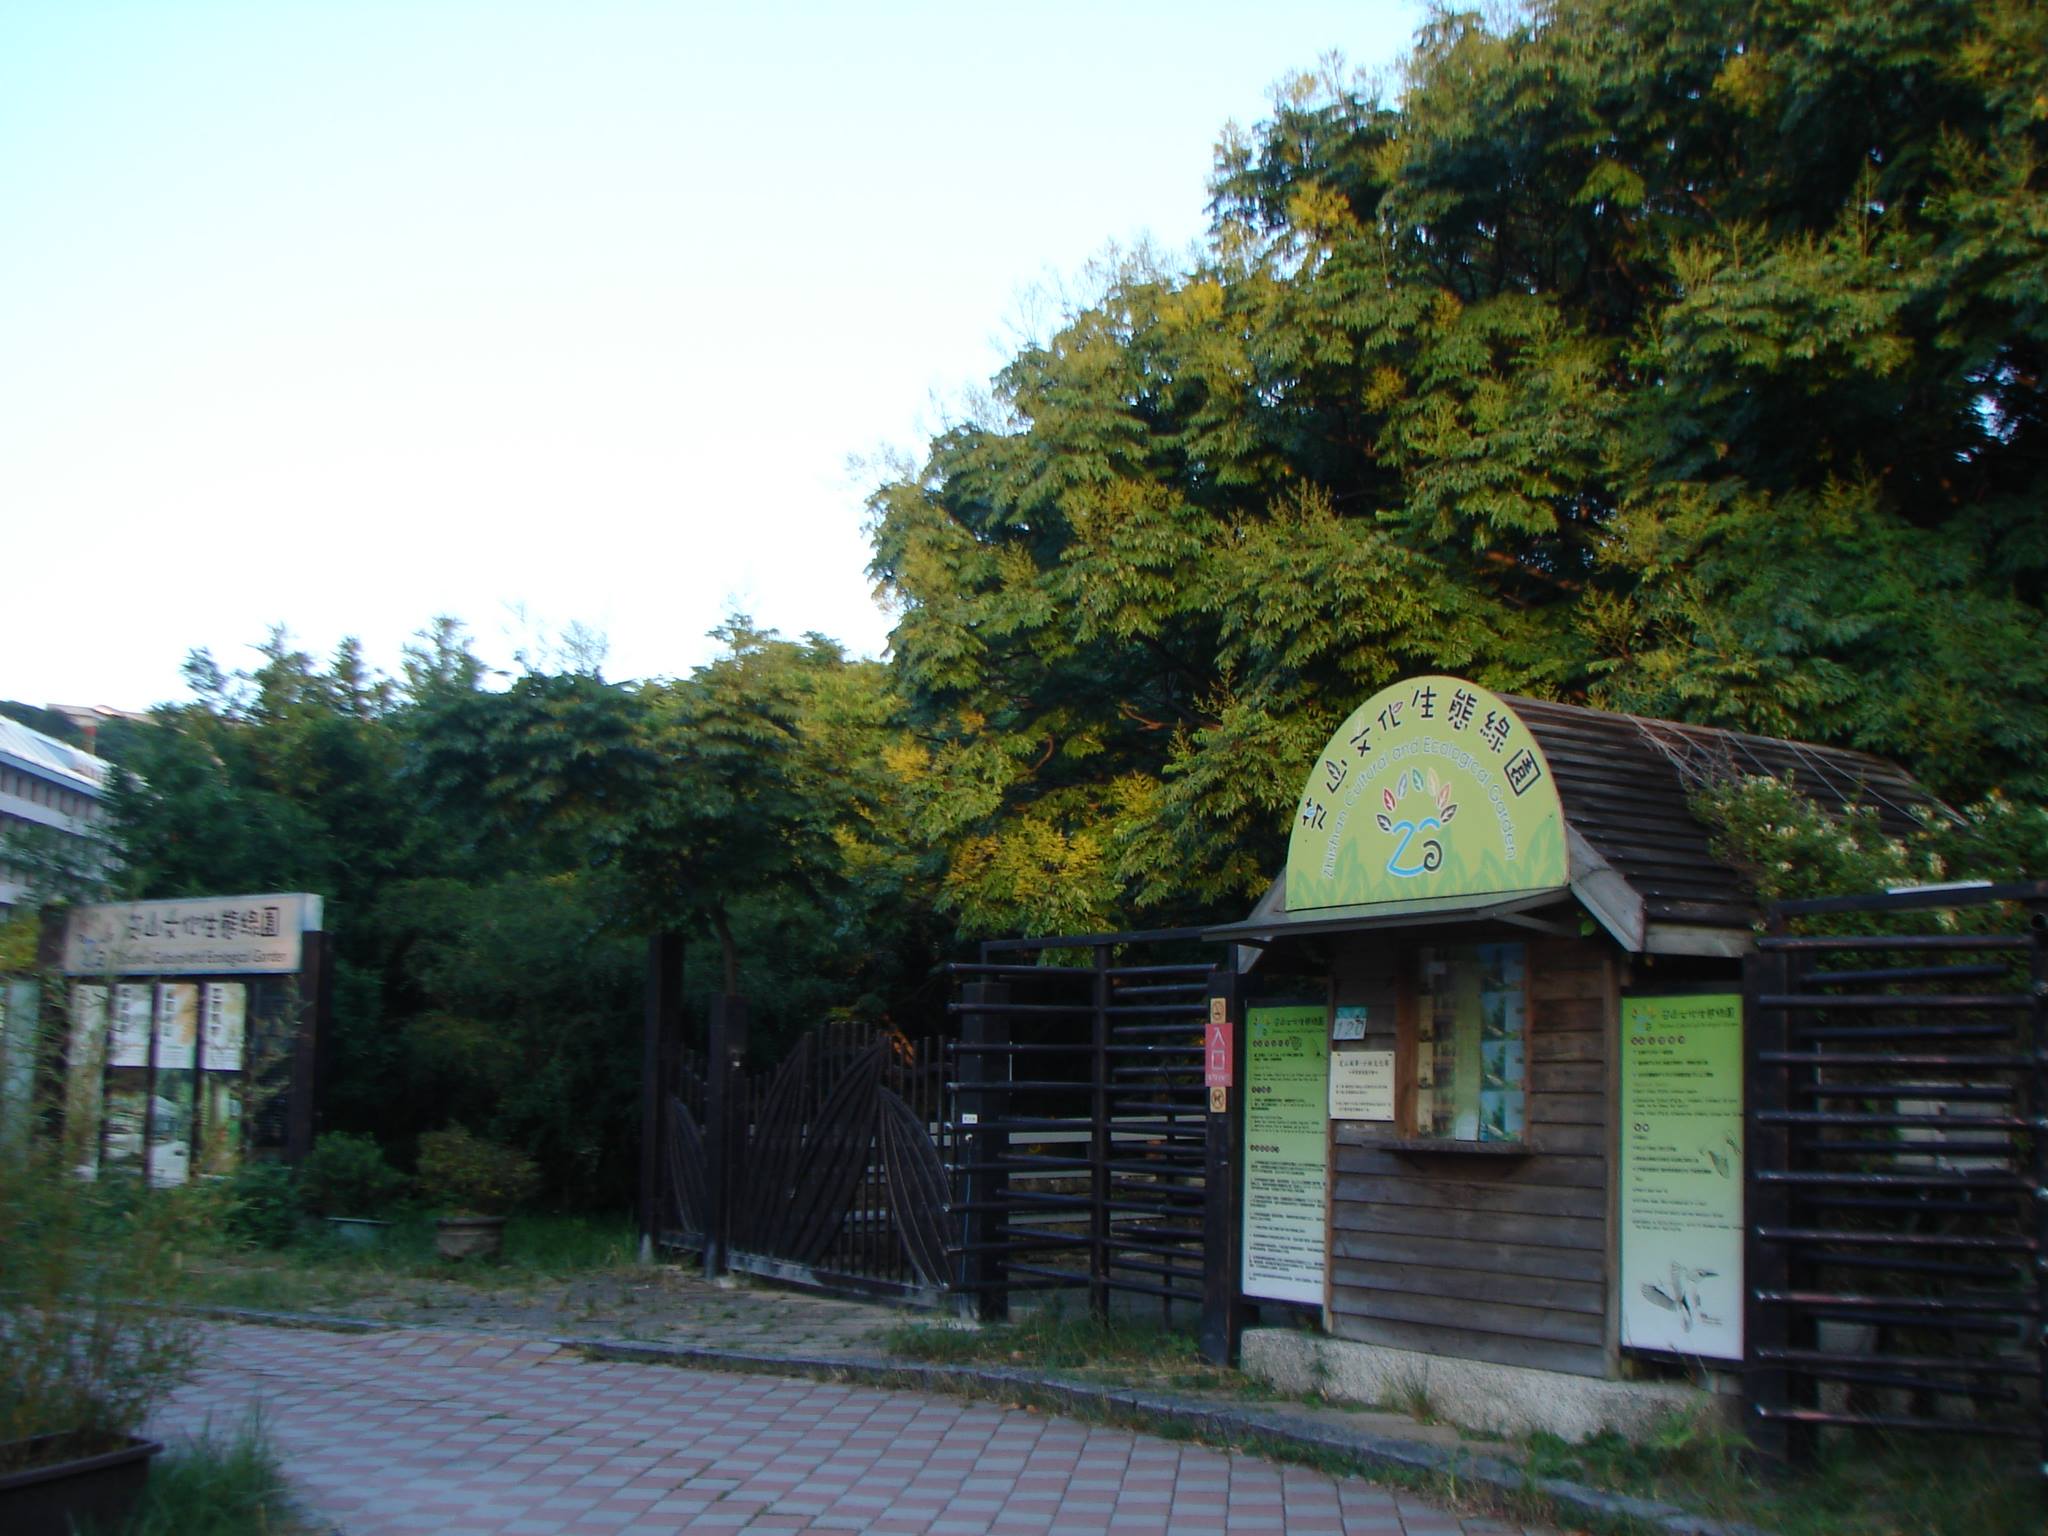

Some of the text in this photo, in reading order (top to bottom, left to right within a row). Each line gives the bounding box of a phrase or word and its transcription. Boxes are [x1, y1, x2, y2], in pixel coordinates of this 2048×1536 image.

[1303, 685, 1541, 830] 芝山文化生態綠園
[1344, 753, 1389, 806] Cultural
[1392, 737, 1419, 761] and
[1422, 736, 1491, 785] Ecological
[1488, 783, 1517, 861] Garden
[1210, 1025, 1227, 1071] 入口
